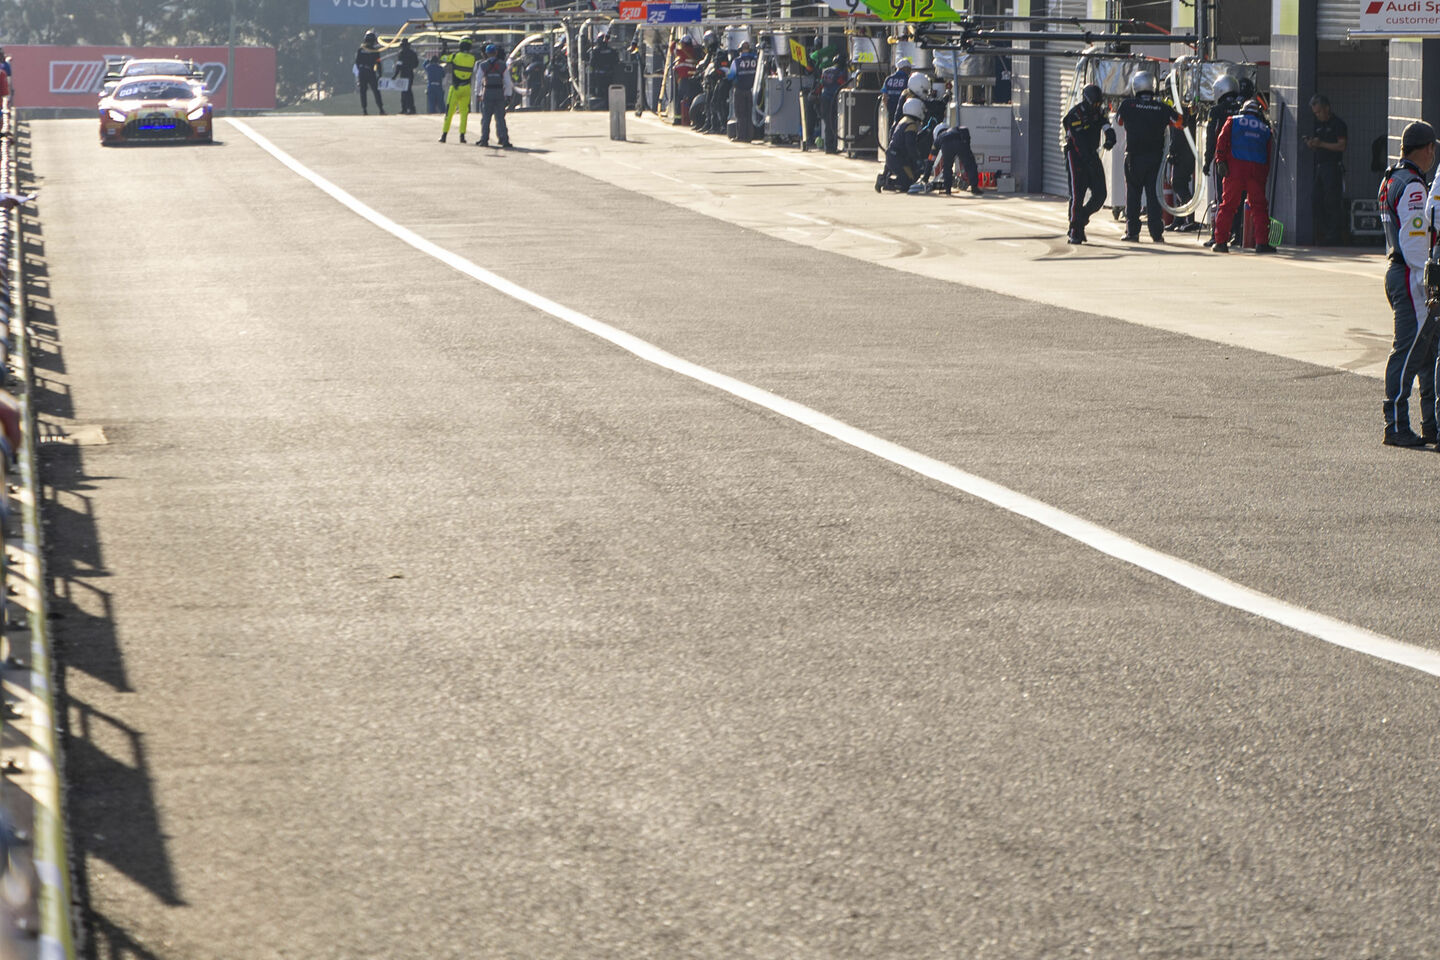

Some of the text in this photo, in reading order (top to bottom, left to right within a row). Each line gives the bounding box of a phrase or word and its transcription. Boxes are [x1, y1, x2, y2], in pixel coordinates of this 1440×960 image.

[1386, 1, 1421, 12] Audi
[621, 7, 641, 18] 230
[648, 10, 667, 21] 25
[1386, 16, 1439, 25] customer
[740, 60, 757, 68] 470
[887, 78, 905, 87] 426
